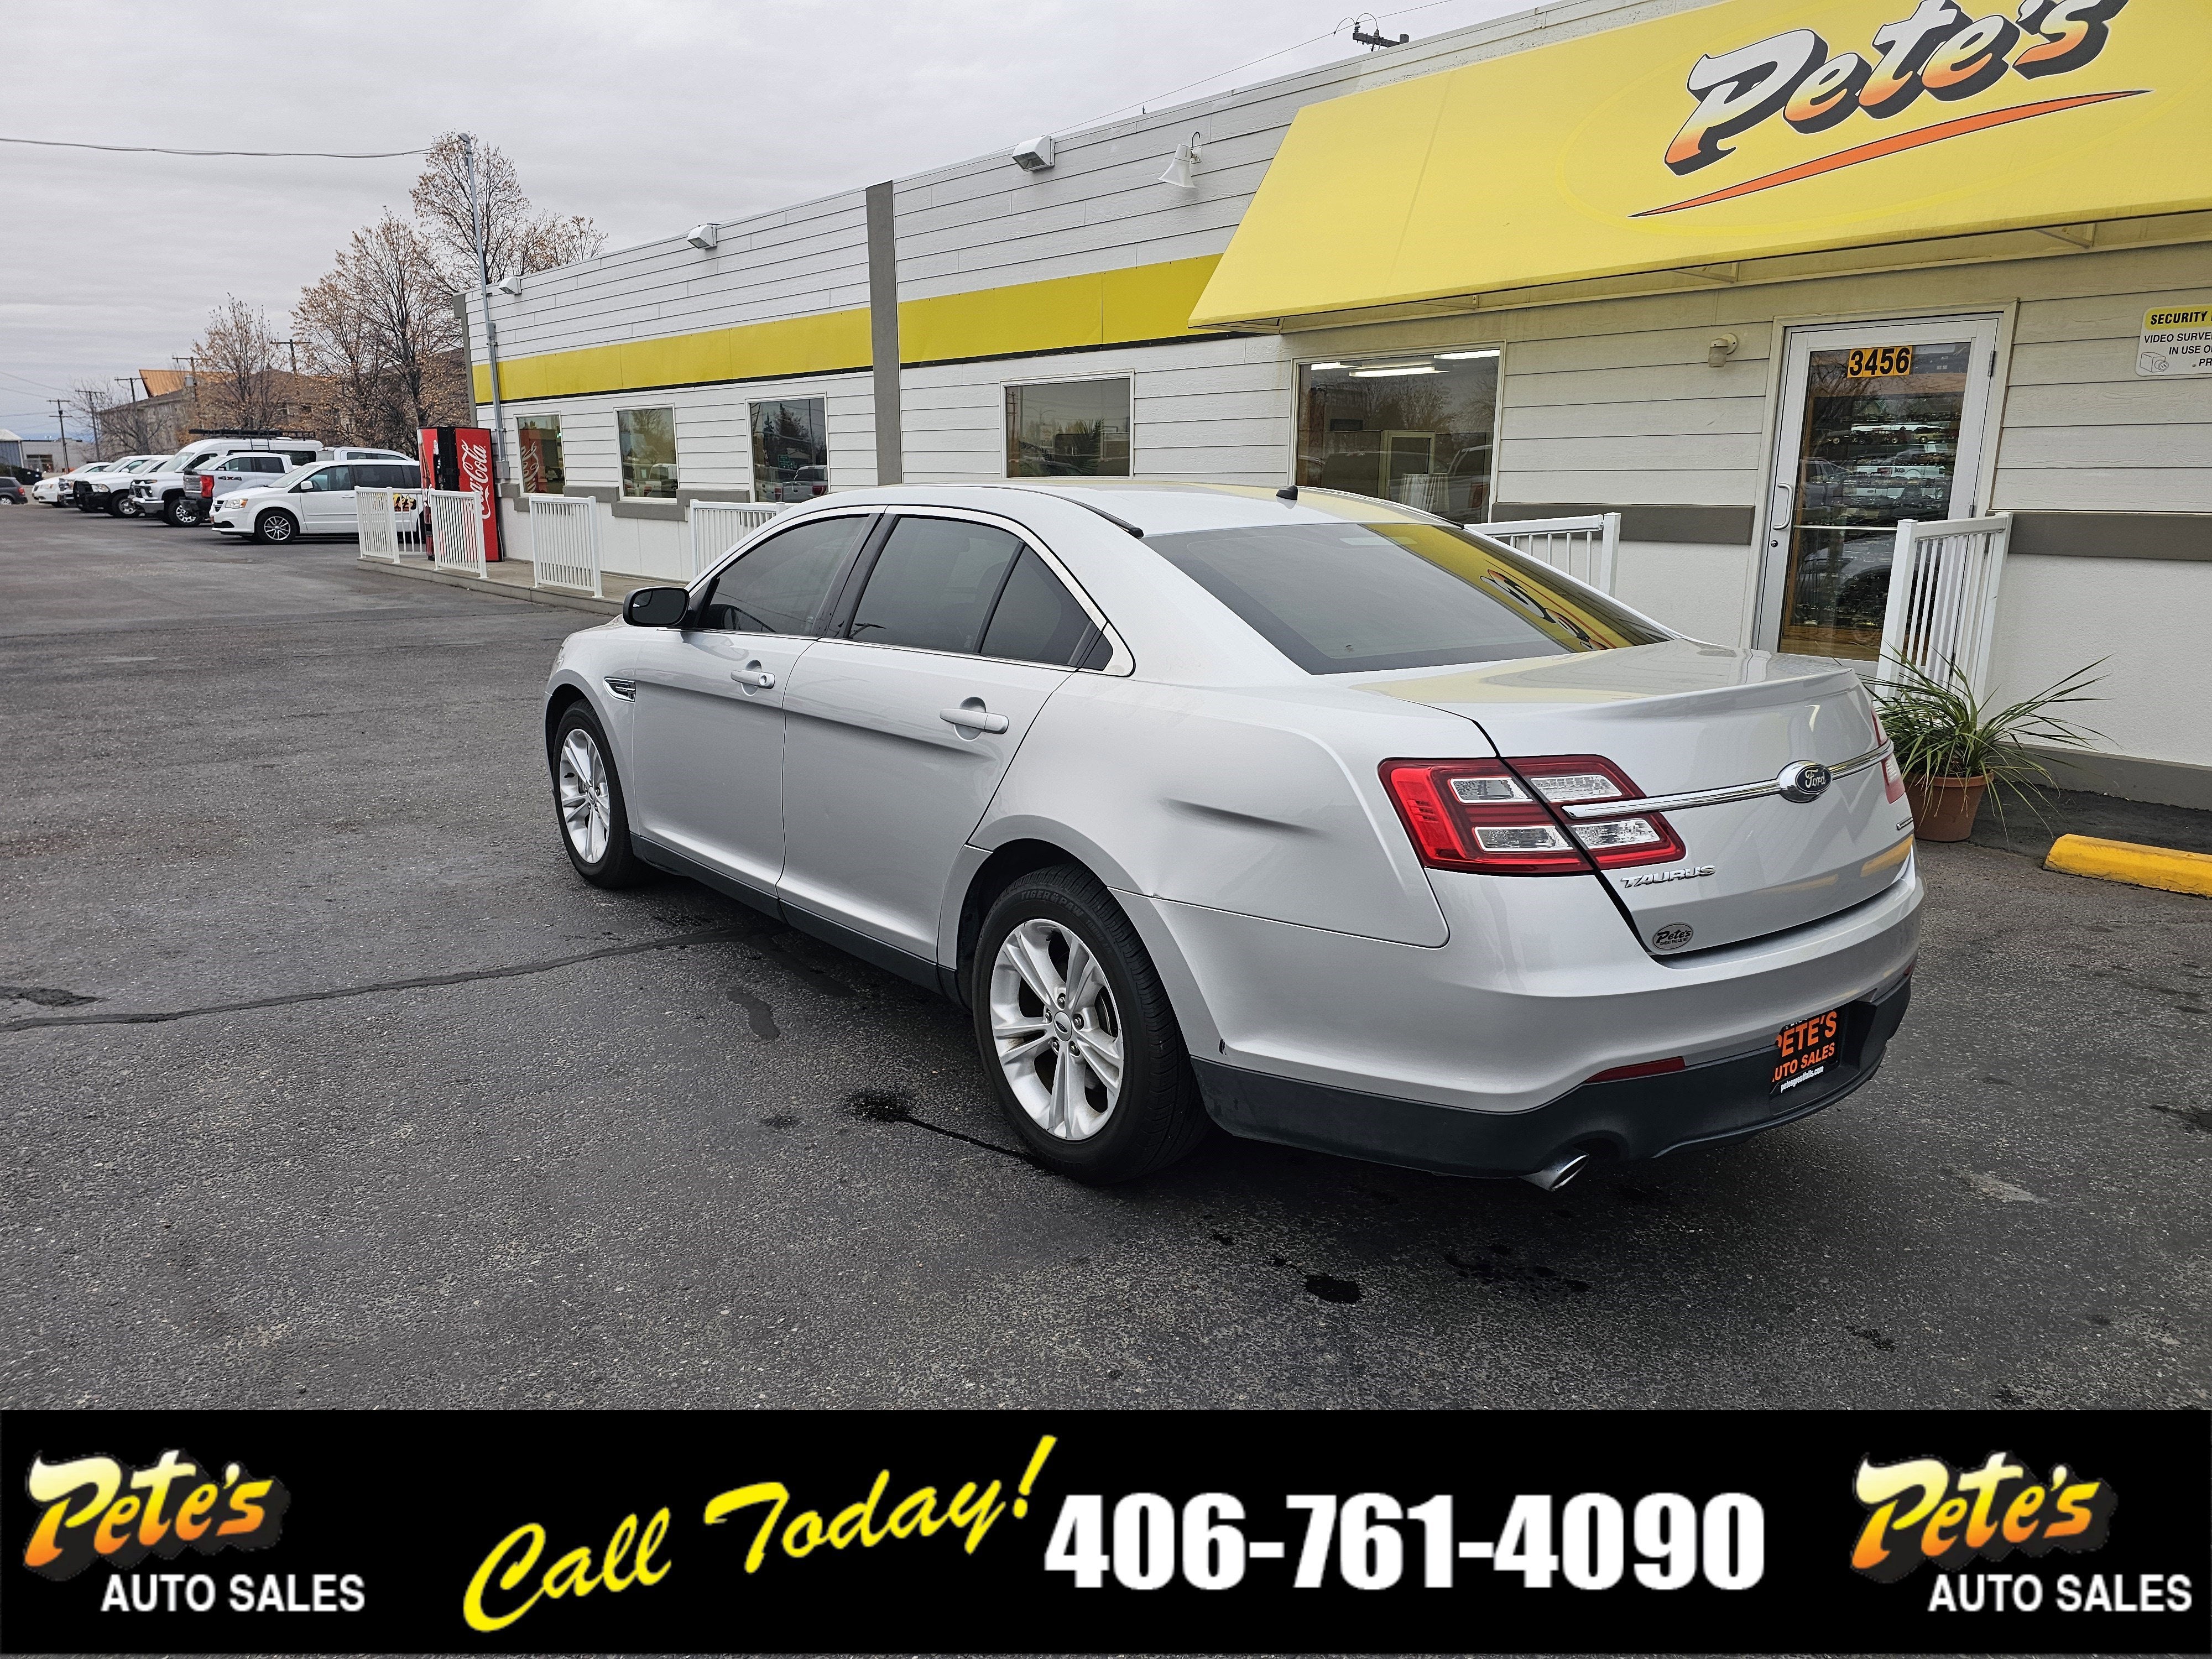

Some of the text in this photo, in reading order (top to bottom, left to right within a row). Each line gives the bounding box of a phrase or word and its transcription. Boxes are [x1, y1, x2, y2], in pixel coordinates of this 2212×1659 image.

[1663, 0, 2129, 176] Pete's
[2151, 311, 2208, 325] SECURITY
[2145, 334, 2174, 343] VIDEO
[2182, 346, 2201, 354] USE
[1849, 346, 1911, 375] 3456
[1805, 769, 1826, 788] Ford
[1621, 865, 1715, 888] TAURUS
[1021, 890, 1051, 900] TIGER
[1656, 930, 1691, 943] Pete's
[1772, 1042, 1835, 1082] UTO SALES
